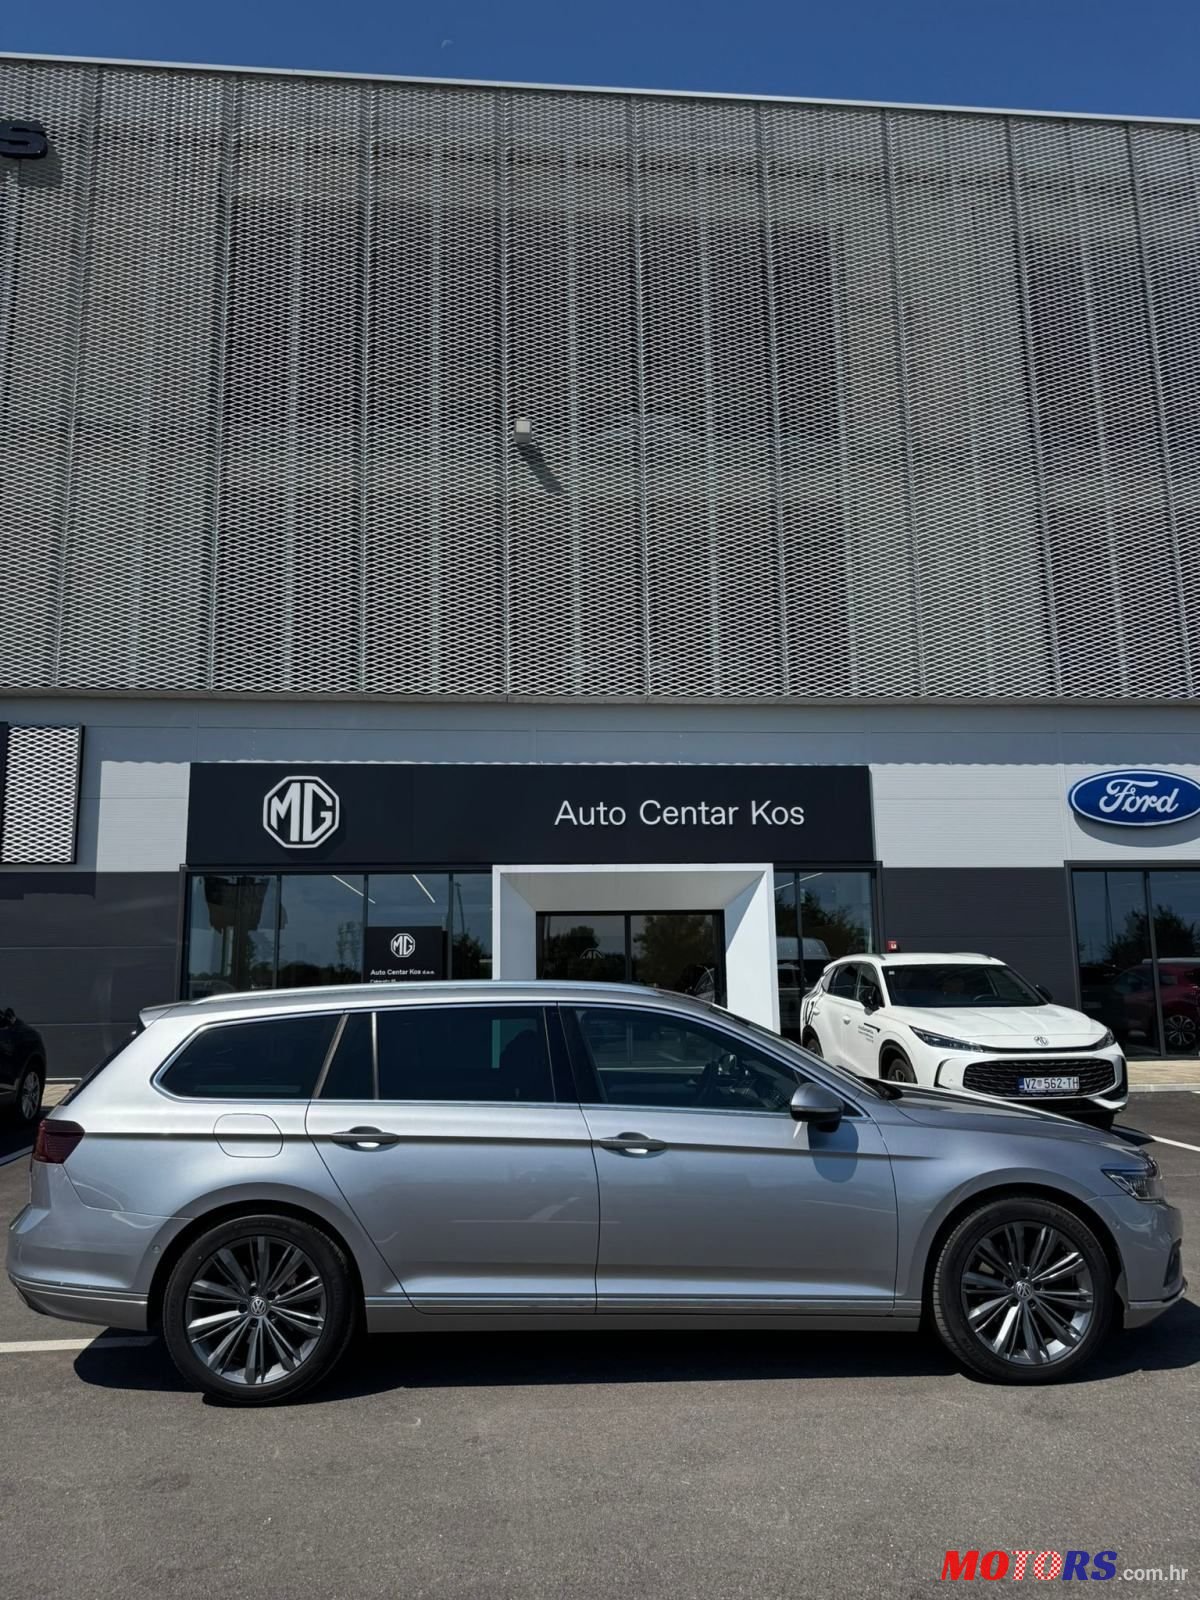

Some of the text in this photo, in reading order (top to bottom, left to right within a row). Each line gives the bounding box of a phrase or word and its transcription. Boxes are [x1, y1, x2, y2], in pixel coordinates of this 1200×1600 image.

[1099, 779, 1179, 813] Ford
[270, 782, 333, 842] MG
[554, 799, 805, 826] Auto Centar Kos
[393, 935, 413, 955] MG
[1025, 1078, 1037, 1089] VZ
